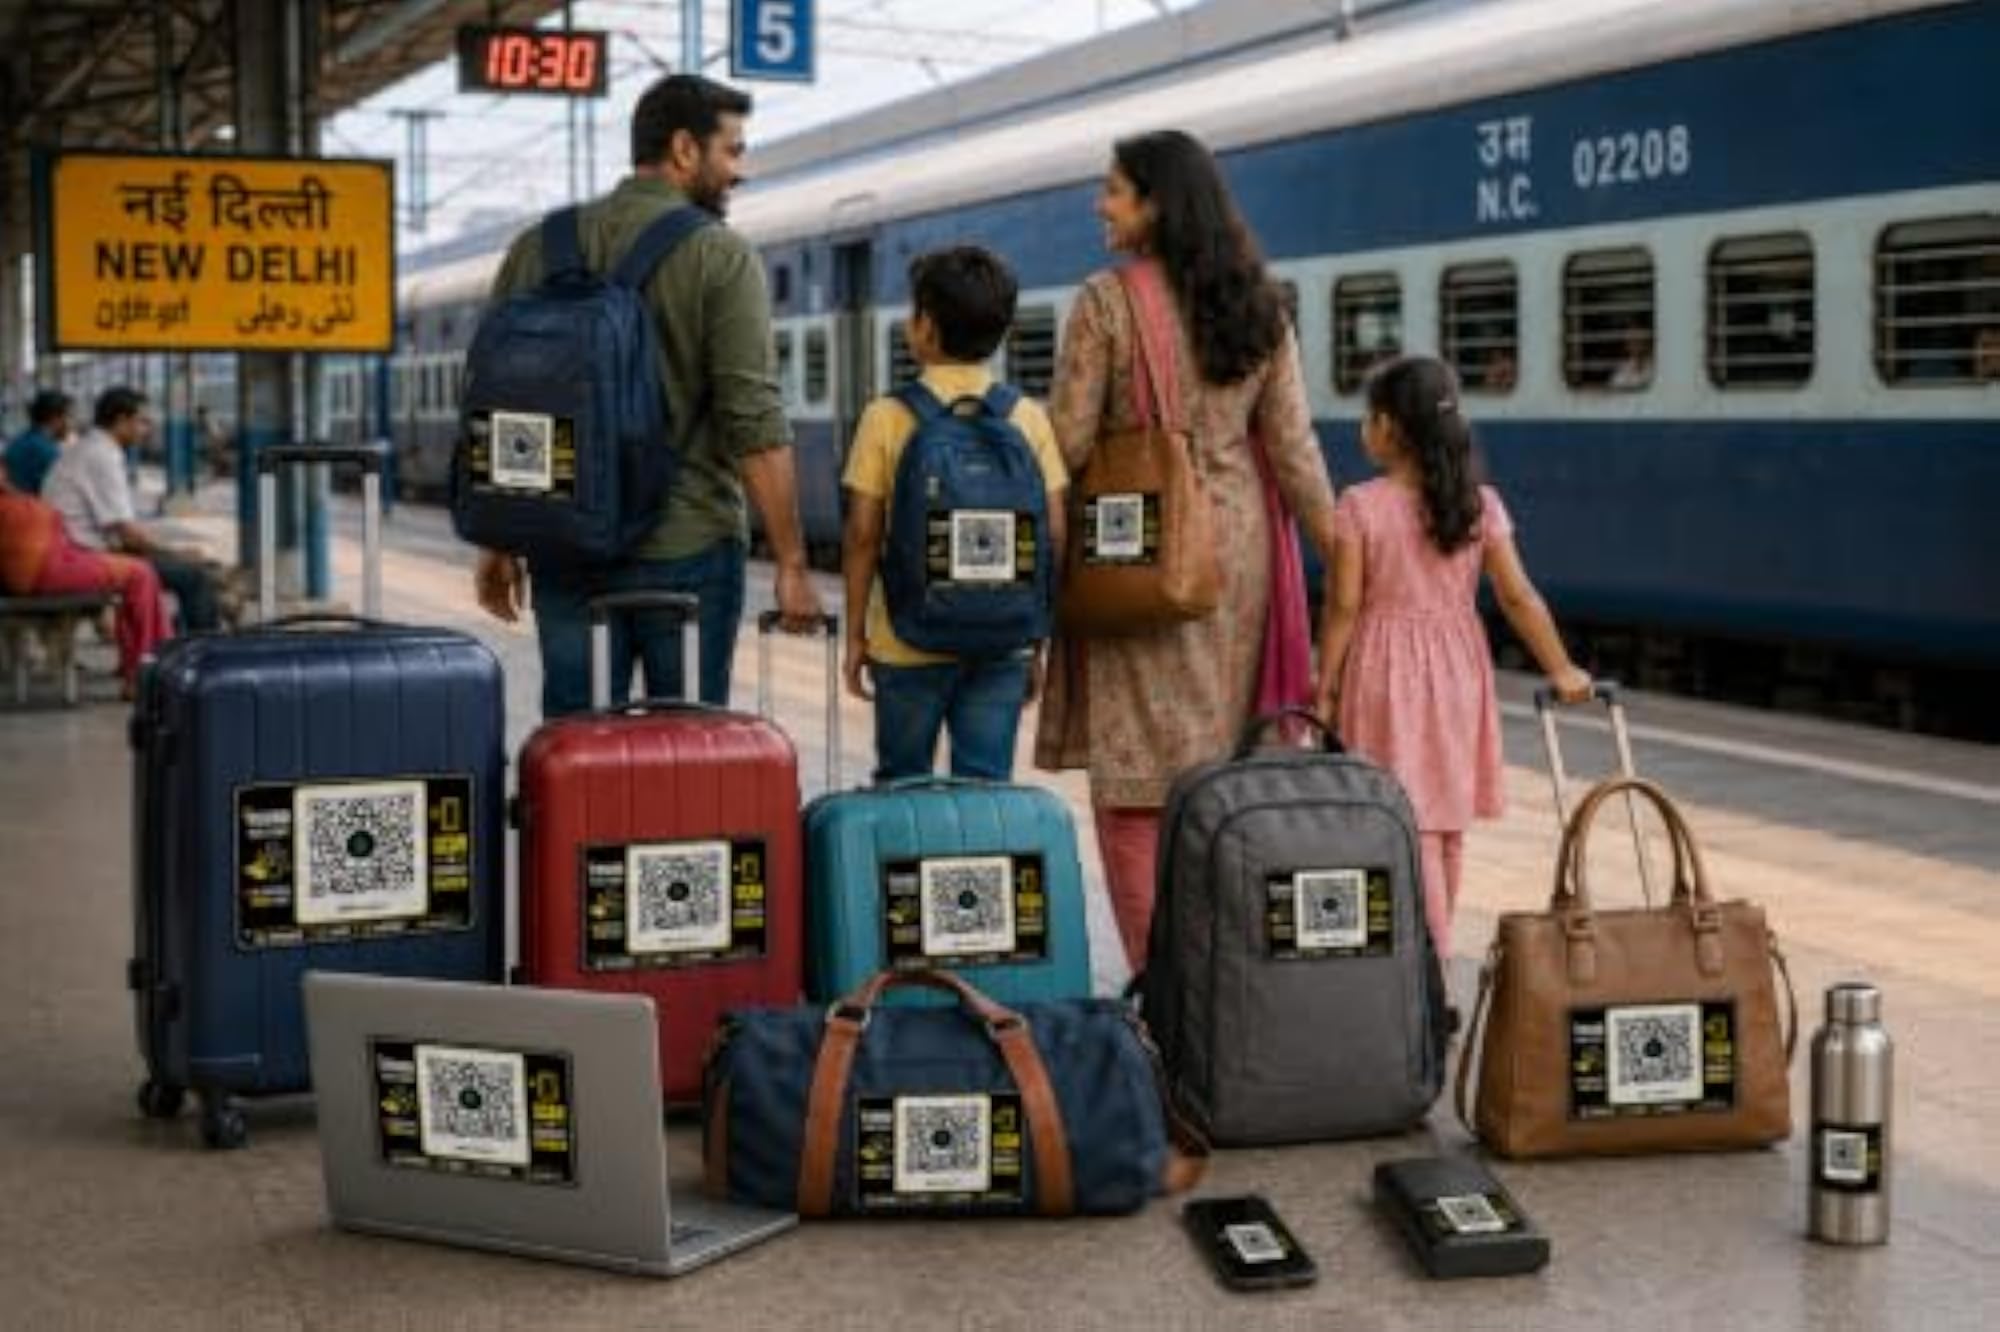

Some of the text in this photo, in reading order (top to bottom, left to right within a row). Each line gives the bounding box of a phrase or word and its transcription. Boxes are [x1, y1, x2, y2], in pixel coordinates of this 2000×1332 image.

[488, 36, 594, 89] 10:30
[756, 3, 797, 64] 5
[1572, 124, 1690, 189] 02208
[117, 171, 335, 232] नई दिल्ली
[95, 240, 357, 286] NEW DELHI
